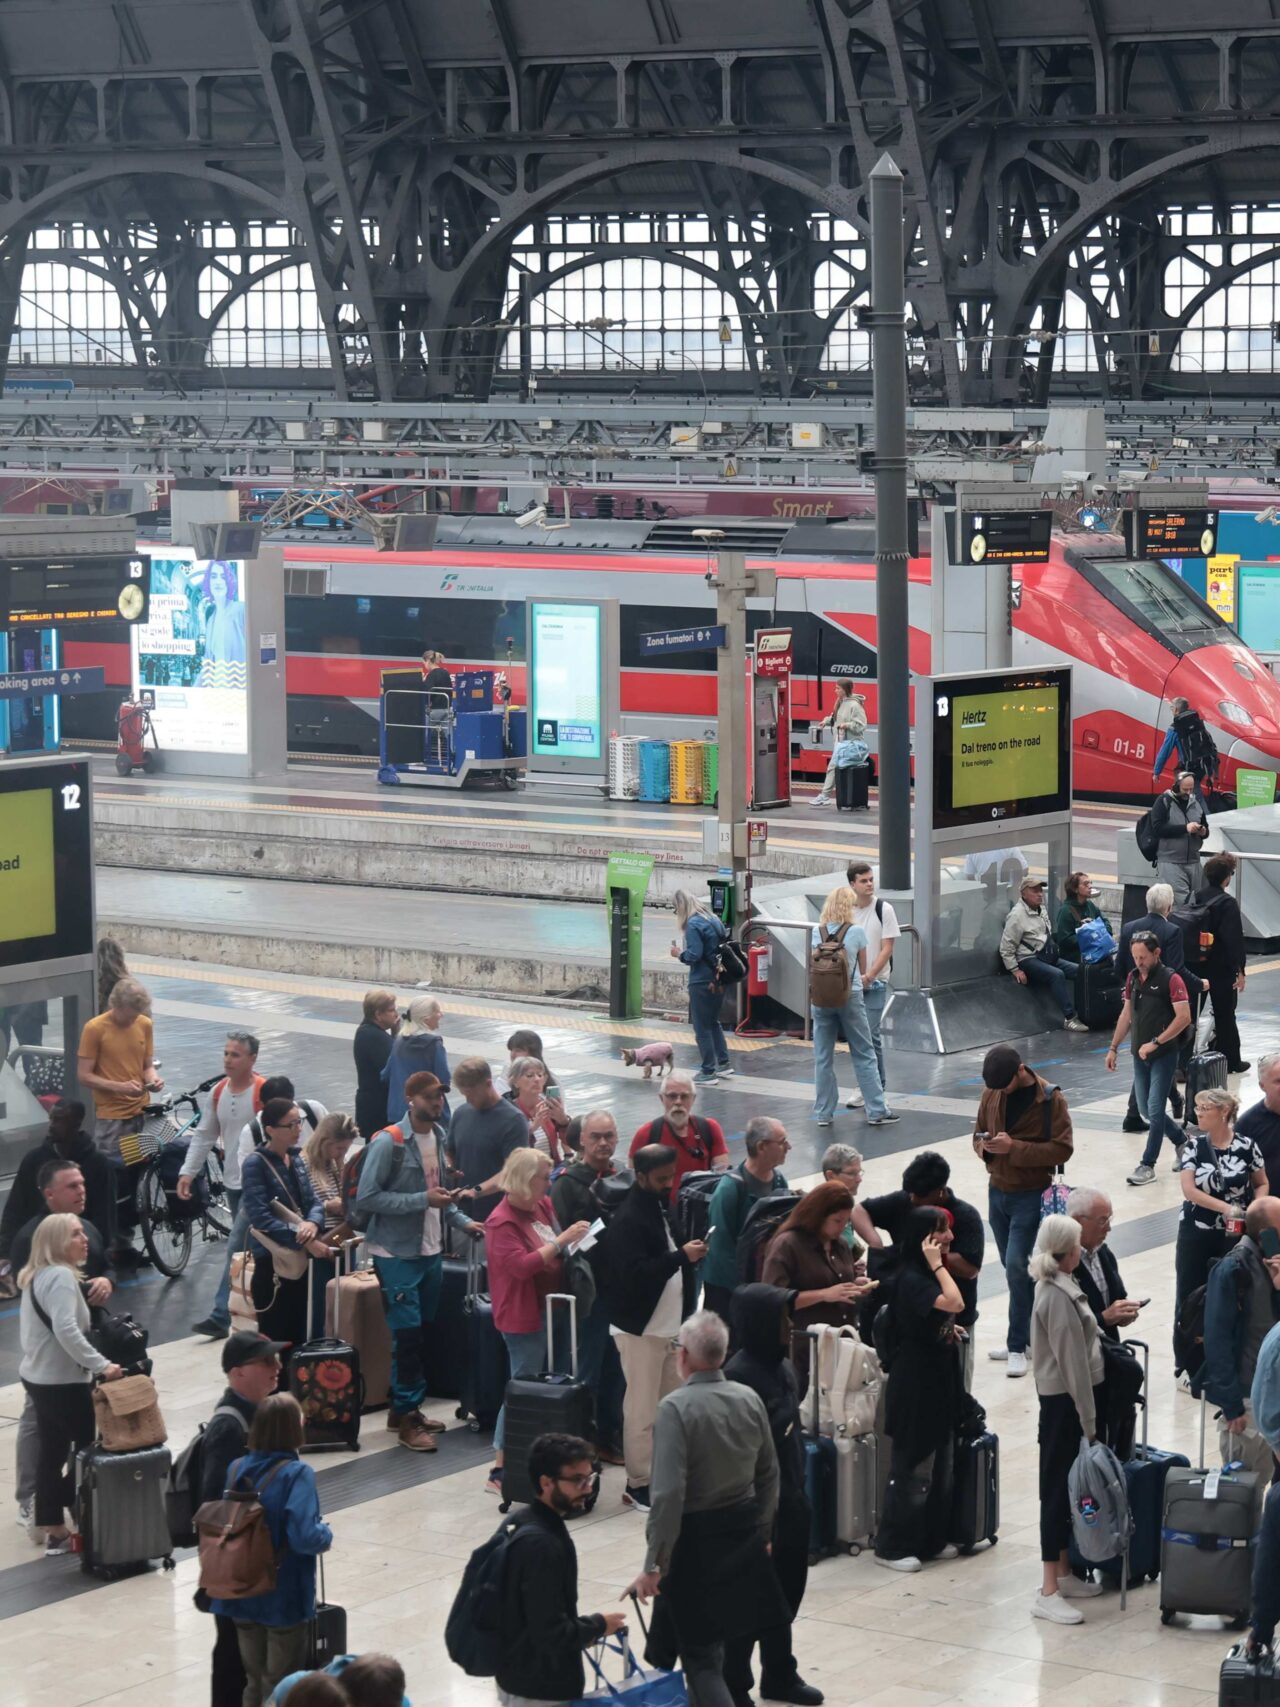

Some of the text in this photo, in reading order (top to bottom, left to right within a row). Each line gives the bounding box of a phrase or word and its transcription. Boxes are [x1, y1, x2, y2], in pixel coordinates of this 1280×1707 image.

[772, 497, 834, 517] Smart
[1166, 517, 1185, 526] SALERNO
[129, 561, 143, 578] 13
[646, 631, 695, 647] Zona fumatori
[830, 664, 869, 674] ETR500
[31, 676, 55, 687] area
[936, 696, 949, 717] 13
[961, 709, 987, 724] Hertz
[961, 735, 1041, 754] Dal treno on the road
[1113, 738, 1146, 759] 01-B
[61, 784, 81, 809] 12
[720, 832, 730, 842] 13
[509, 841, 531, 850] binari
[577, 846, 588, 855] Do
[589, 847, 602, 855] not
[666, 853, 684, 861] lines
